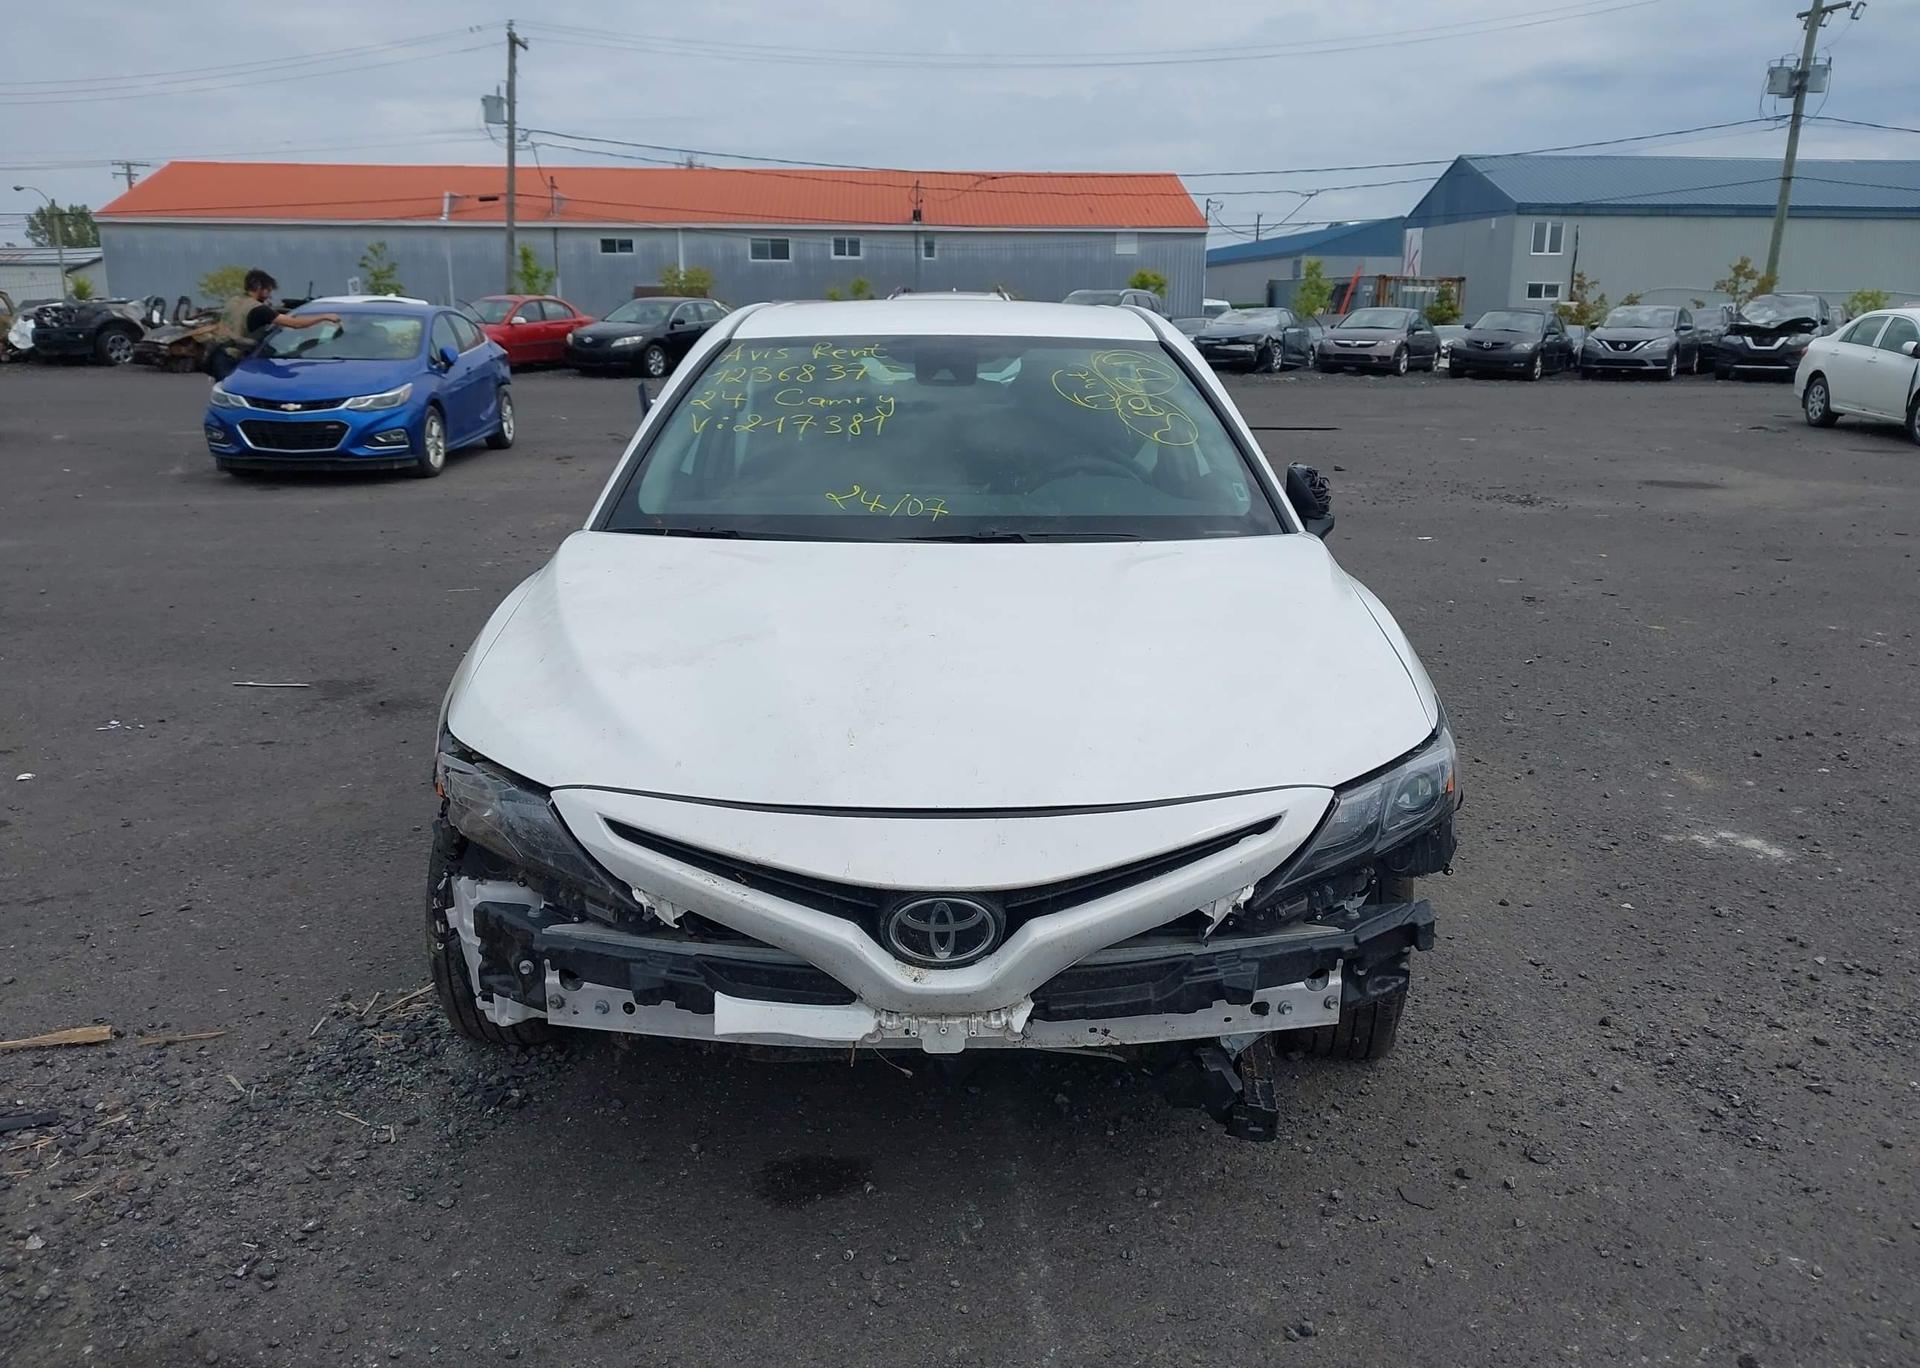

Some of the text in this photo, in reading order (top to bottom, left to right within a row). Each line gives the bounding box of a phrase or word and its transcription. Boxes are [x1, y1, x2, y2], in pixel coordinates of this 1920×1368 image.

[719, 342, 889, 363] Avis Rent
[774, 388, 895, 417] Camry
[824, 484, 950, 522] 24/07
